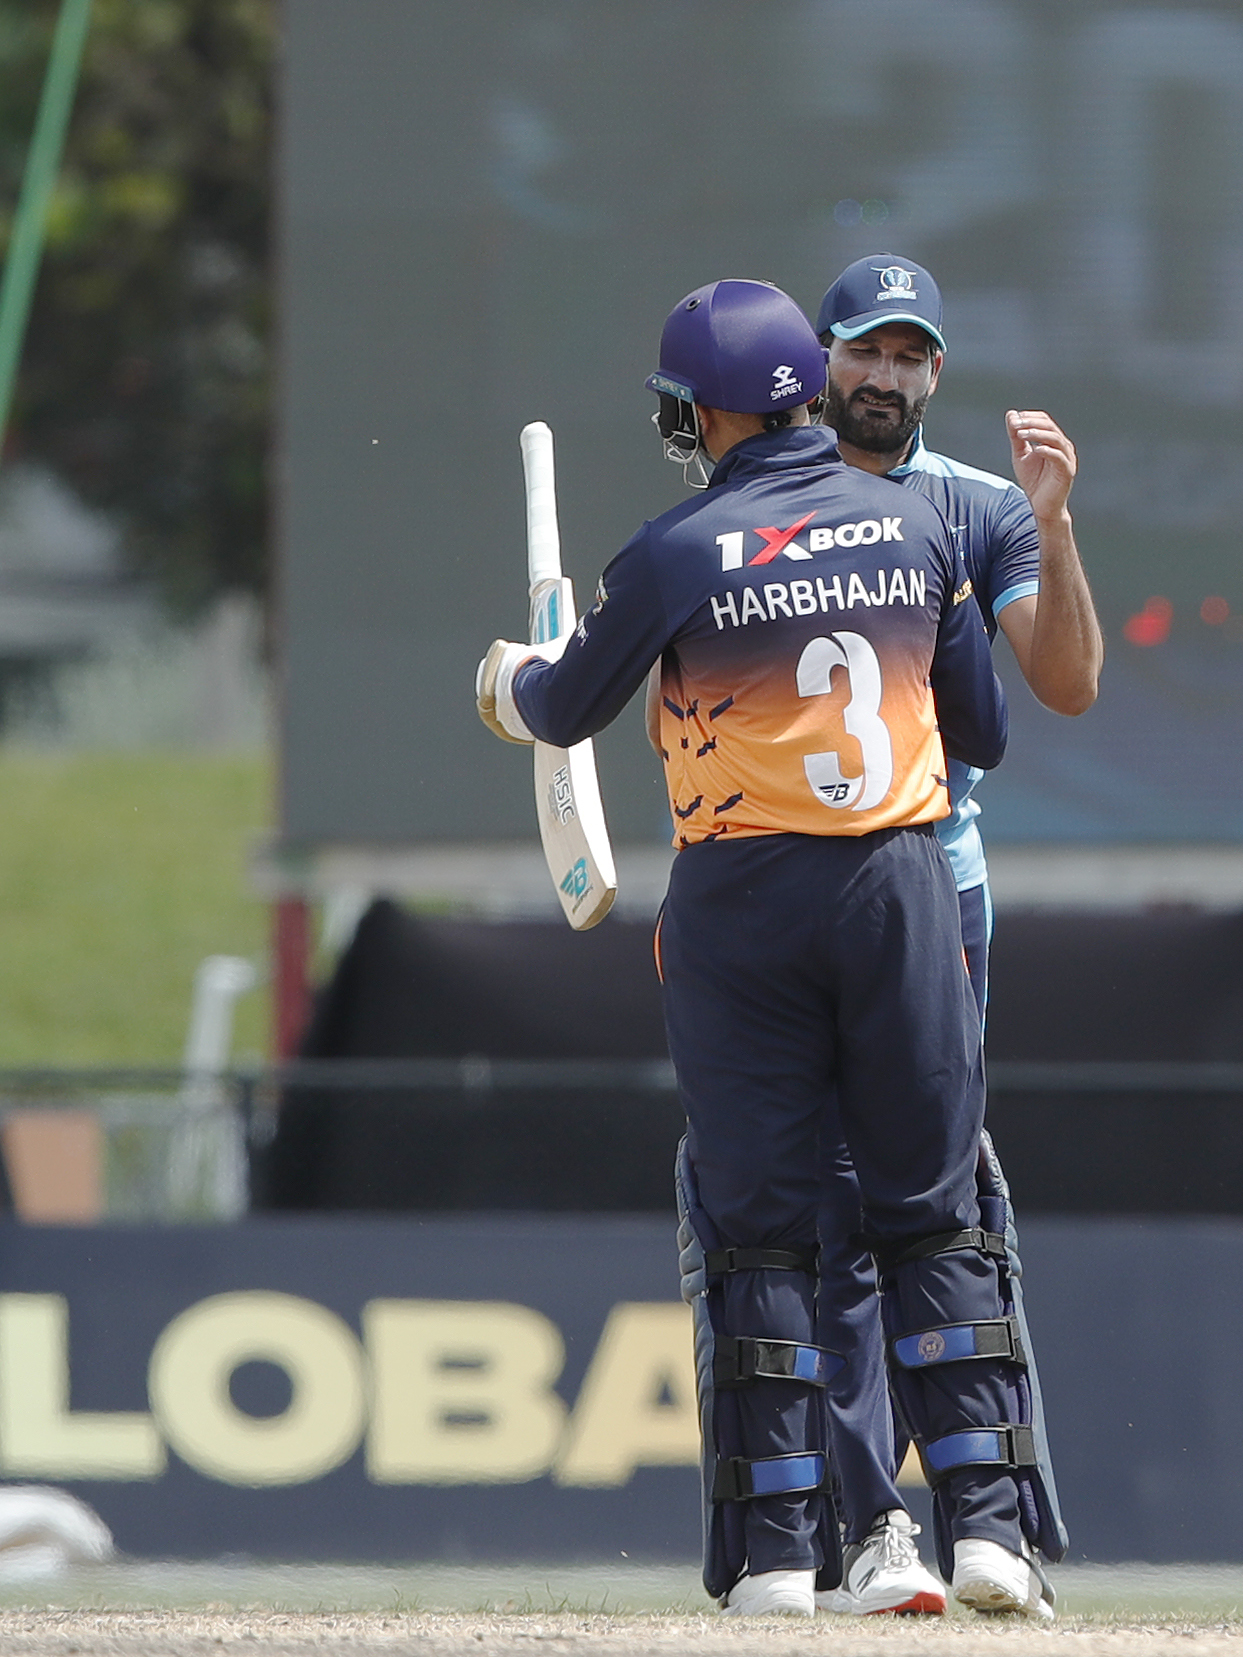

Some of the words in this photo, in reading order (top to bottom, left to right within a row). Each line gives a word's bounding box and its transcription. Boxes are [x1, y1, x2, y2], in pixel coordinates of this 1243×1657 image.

[770, 382, 802, 400] SHREY
[709, 566, 927, 631] HARBHAJAN
[796, 630, 894, 812] 3
